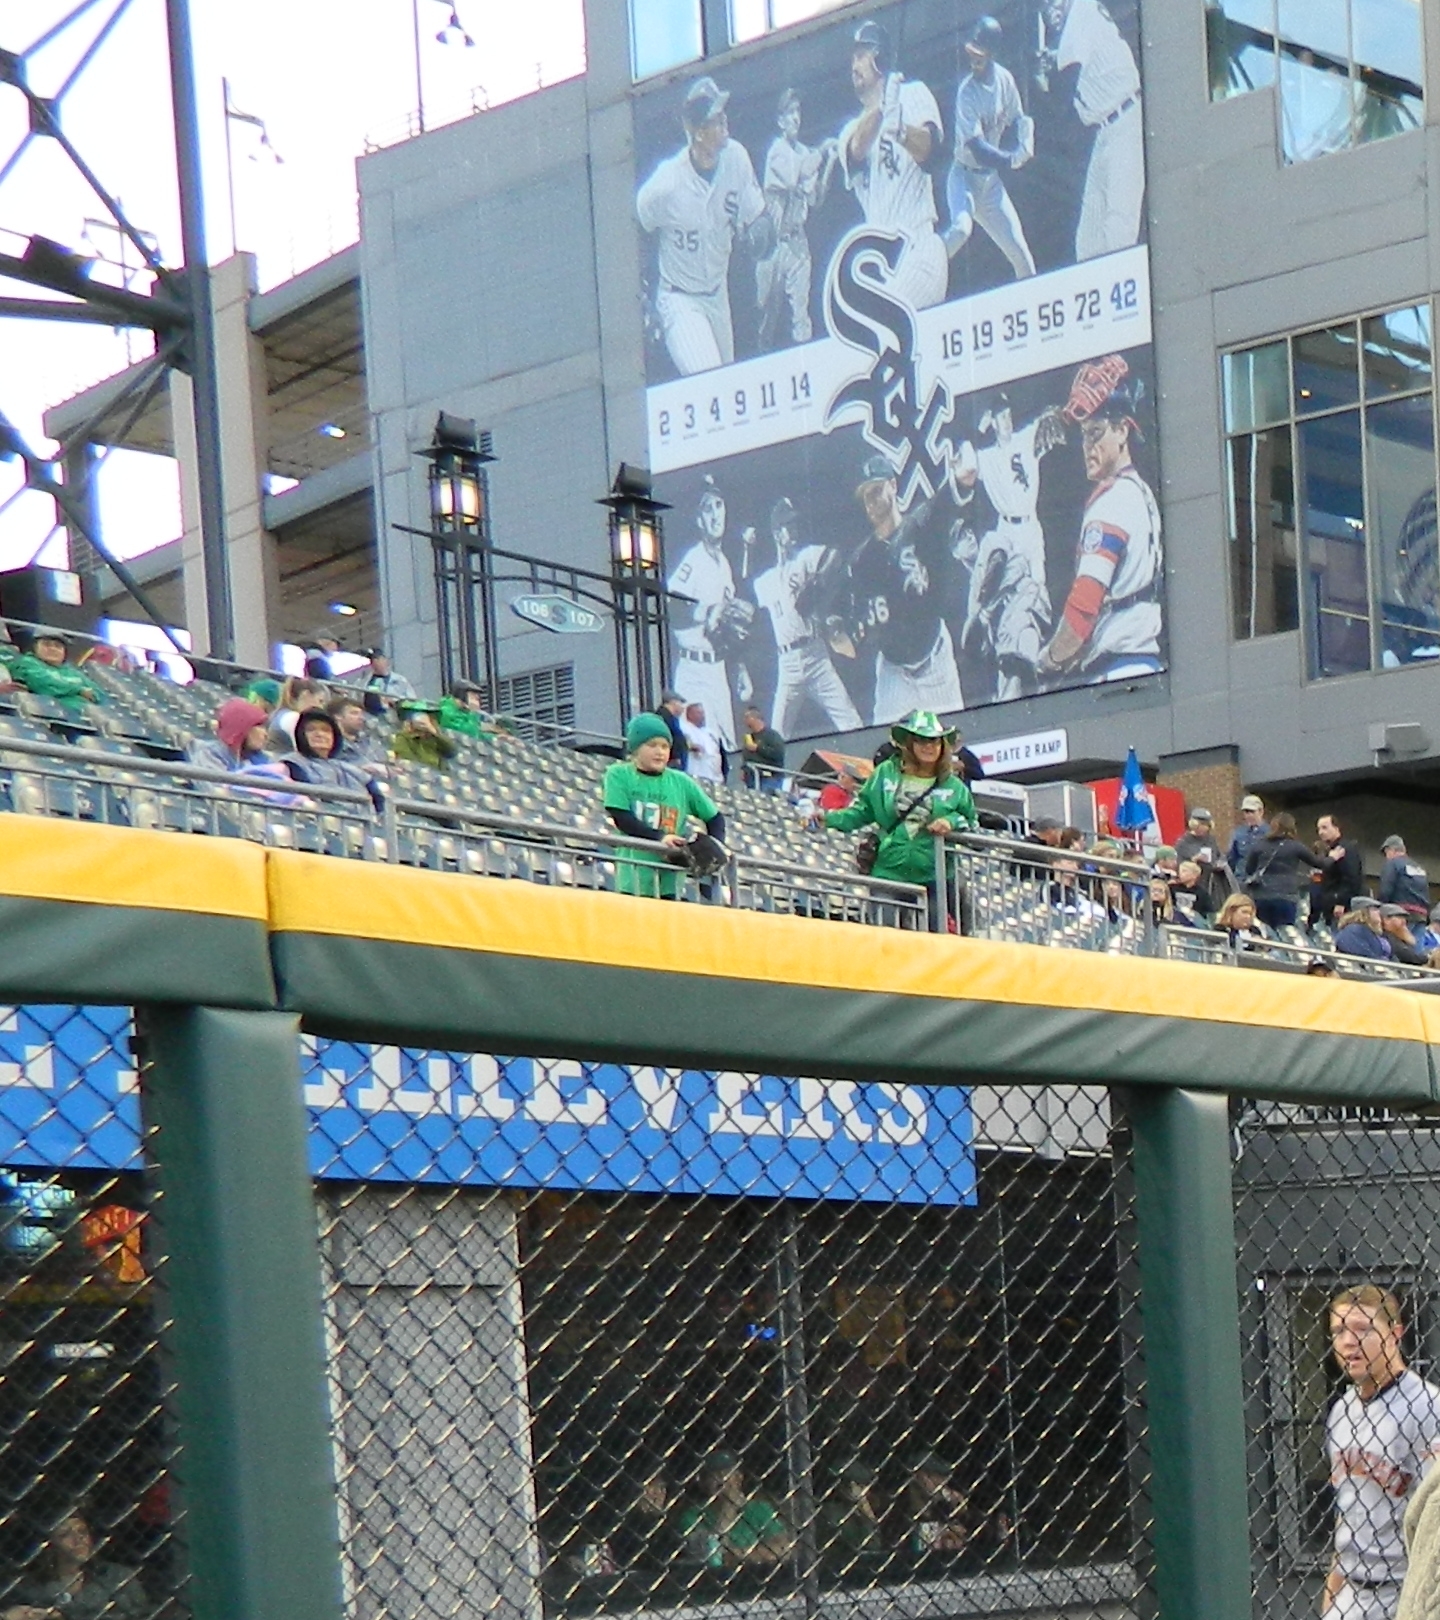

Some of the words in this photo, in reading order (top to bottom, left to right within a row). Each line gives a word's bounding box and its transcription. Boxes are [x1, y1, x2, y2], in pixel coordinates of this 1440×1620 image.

[942, 329, 963, 360] 16
[972, 320, 993, 351] 19
[1003, 310, 1028, 343] 35
[1038, 300, 1065, 332] 56
[1074, 289, 1101, 322] 72
[1110, 279, 1137, 311] 42
[659, 410, 671, 436] 2
[684, 403, 696, 429] 3
[710, 397, 721, 422] 4
[735, 390, 747, 416] 9
[761, 382, 776, 409] 11
[791, 372, 811, 401] 14
[570, 610, 594, 627] 107
[996, 747, 1020, 762] GATE
[1025, 745, 1031, 758] 2
[1034, 739, 1062, 756] RAMP
